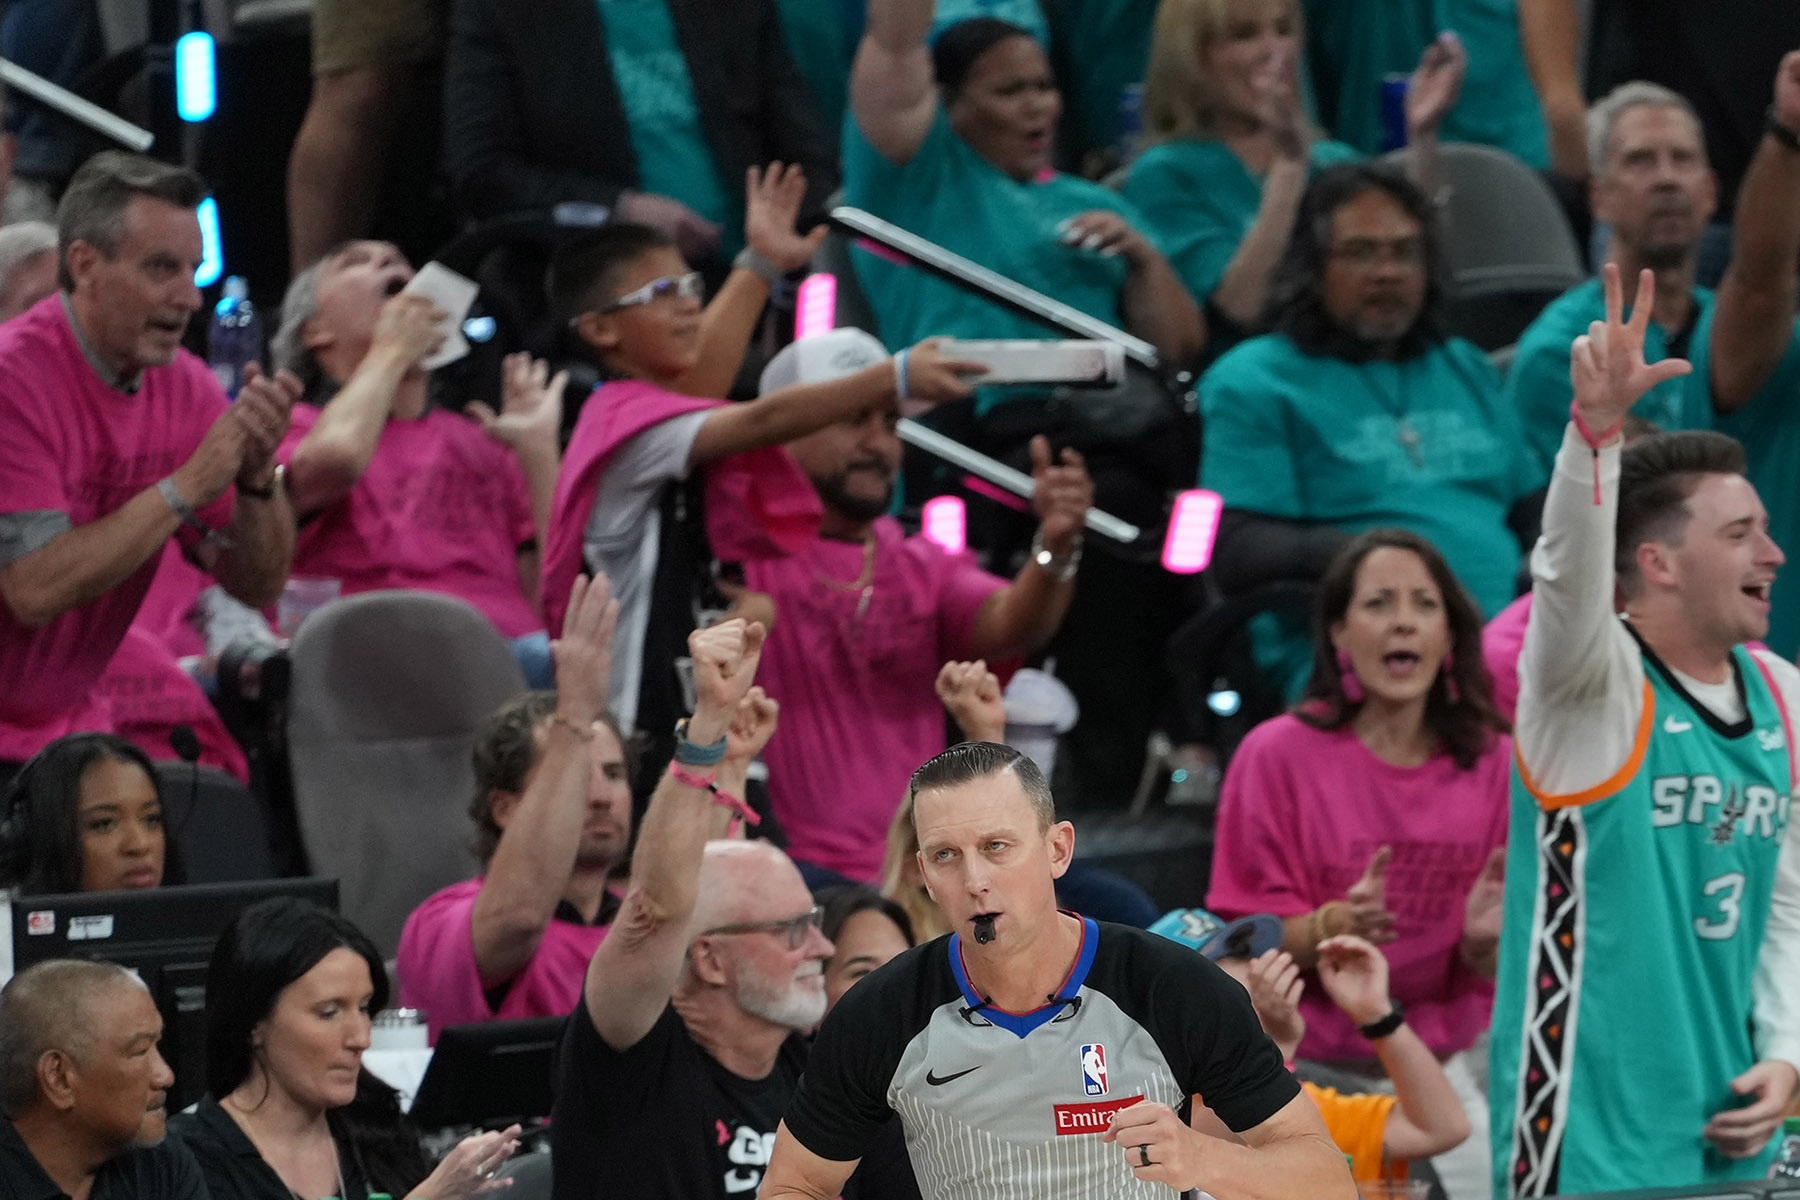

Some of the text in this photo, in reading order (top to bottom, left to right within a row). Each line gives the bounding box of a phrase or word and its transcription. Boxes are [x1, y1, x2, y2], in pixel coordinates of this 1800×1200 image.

[1693, 872, 1746, 940] 3
[1087, 1084, 1101, 1094] NBA
[1057, 1106, 1124, 1128] Emira
